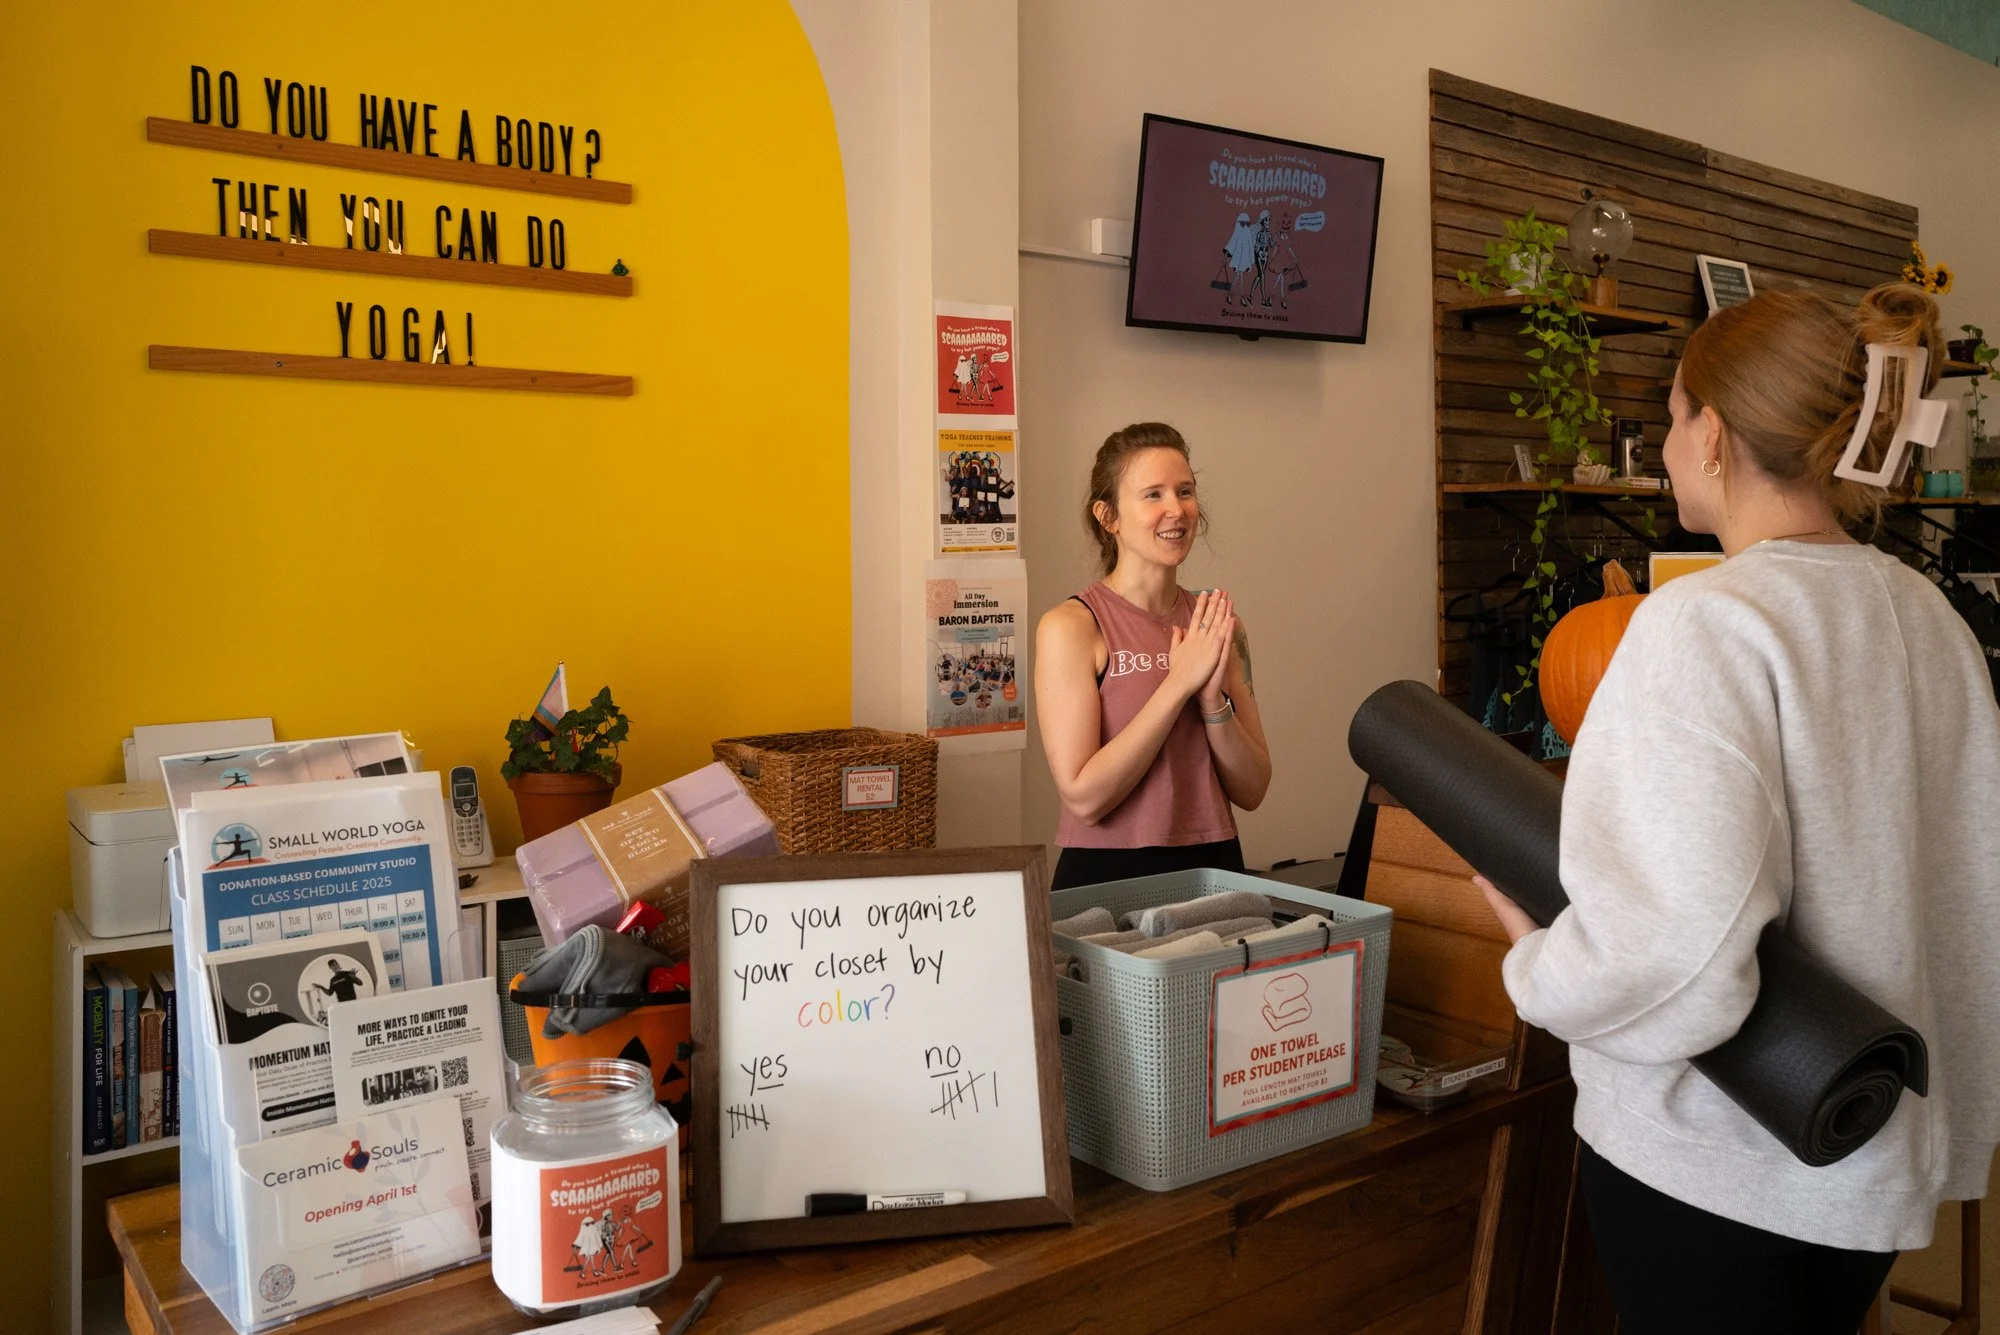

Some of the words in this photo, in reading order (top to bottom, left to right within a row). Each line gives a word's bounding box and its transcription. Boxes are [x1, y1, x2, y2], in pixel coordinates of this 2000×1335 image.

[191, 65, 239, 128] DO
[264, 77, 328, 141] YOU
[360, 93, 439, 157] HAVE
[458, 110, 475, 162] A
[1223, 149, 1232, 158] Do
[1249, 155, 1265, 163] have
[1275, 154, 1296, 163] friend
[1226, 195, 1233, 203] to
[1236, 197, 1248, 208] try
[1251, 197, 1262, 206] hot
[1265, 194, 1288, 206] power
[212, 178, 309, 246] THEN
[340, 193, 404, 255] YOU
[436, 205, 497, 264] CAN
[528, 216, 565, 270] DO
[336, 302, 477, 366] YOGA!
[953, 600, 999, 609] Immersion
[939, 615, 969, 625] BARON
[971, 614, 1014, 624] BAPTISTE
[1110, 651, 1151, 677] Be
[269, 832, 319, 849] SMALL
[322, 825, 378, 843] WORLD
[383, 820, 425, 834] YOGA
[275, 848, 317, 860] Connecting
[346, 841, 379, 852] Creating
[220, 872, 312, 891] DONATION-BASED
[314, 863, 377, 879] COMMUNITY
[380, 857, 416, 870] STUDIO
[252, 891, 291, 906] CLASS
[293, 881, 358, 899] SCHEDULE
[362, 876, 392, 889] 2025
[228, 925, 244, 935] SUN
[257, 920, 275, 930] MON
[288, 916, 301, 926] TUE
[316, 911, 332, 921] WED
[345, 907, 362, 918] THUR
[377, 903, 387, 912] FRI
[404, 898, 415, 908] SAT
[373, 920, 389, 929] 9:00
[402, 915, 417, 923] 9:00
[732, 907, 768, 936] Do
[792, 905, 841, 950] you
[868, 895, 976, 939] organize
[402, 931, 419, 940] 10:30
[734, 960, 793, 1000] your
[815, 947, 887, 978] closet
[910, 945, 943, 983] by
[246, 1004, 278, 1017] BAPTISTE
[798, 983, 895, 1027] color?
[93, 996, 104, 1044] MOBILITY
[358, 1021, 381, 1035] MORE
[384, 1017, 407, 1030] WAYS
[410, 1014, 419, 1024] TO
[421, 1009, 445, 1023] IGNITE
[448, 1004, 468, 1017] YOUR
[366, 1036, 384, 1047] LIFE,
[387, 1027, 424, 1042] PRACTICE
[427, 1026, 432, 1034] &
[435, 1018, 466, 1032] LEADING
[95, 1048, 103, 1066] FOR
[249, 1046, 310, 1071] MOMENTUM
[1251, 1044, 1276, 1060] ONE
[1281, 1033, 1319, 1053] TOWEL
[95, 1068, 104, 1086] LIFE
[741, 1053, 788, 1096] yes
[925, 1045, 961, 1068] no
[1223, 1070, 1245, 1088] PER
[1250, 1054, 1304, 1080] STUDENT
[1307, 1043, 1346, 1065] PLEASE
[1444, 1073, 1465, 1085] STICKER
[1476, 1063, 1496, 1074] MAGNET
[1241, 1093, 1276, 1107] AVAILABLE
[1290, 1084, 1305, 1093] RENT
[1307, 1080, 1319, 1088] FOR
[1243, 1088, 1258, 1096] FULL
[1261, 1080, 1285, 1092] LENGTH
[1287, 1076, 1301, 1084] MAT
[1303, 1068, 1326, 1080] TOWELS
[263, 1157, 341, 1187] Ceramic
[371, 1139, 419, 1160] Souls
[305, 1200, 363, 1222] Opening
[366, 1189, 397, 1206] April
[401, 1184, 417, 1196] 1st
